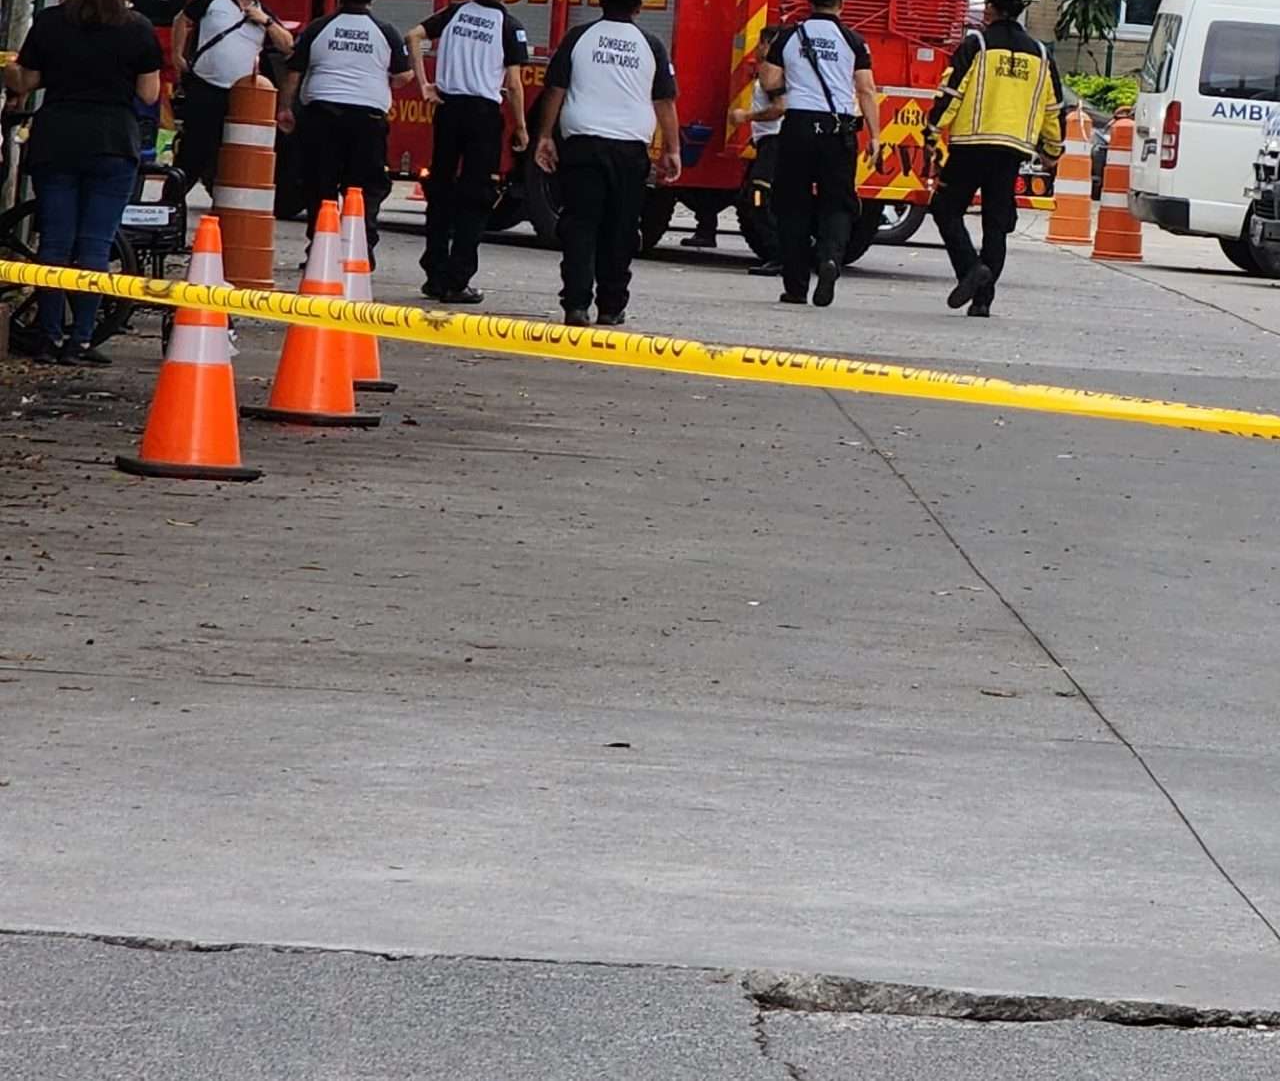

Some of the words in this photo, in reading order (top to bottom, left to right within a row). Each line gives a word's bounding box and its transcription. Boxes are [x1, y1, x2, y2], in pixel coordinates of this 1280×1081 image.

[458, 13, 495, 30] BOMBEROS
[335, 27, 370, 40] BOMBEROS
[328, 39, 374, 54] VOLUNTARIOS
[598, 36, 638, 52] BOMBEROS
[592, 50, 640, 69] VOLUNTARIOS
